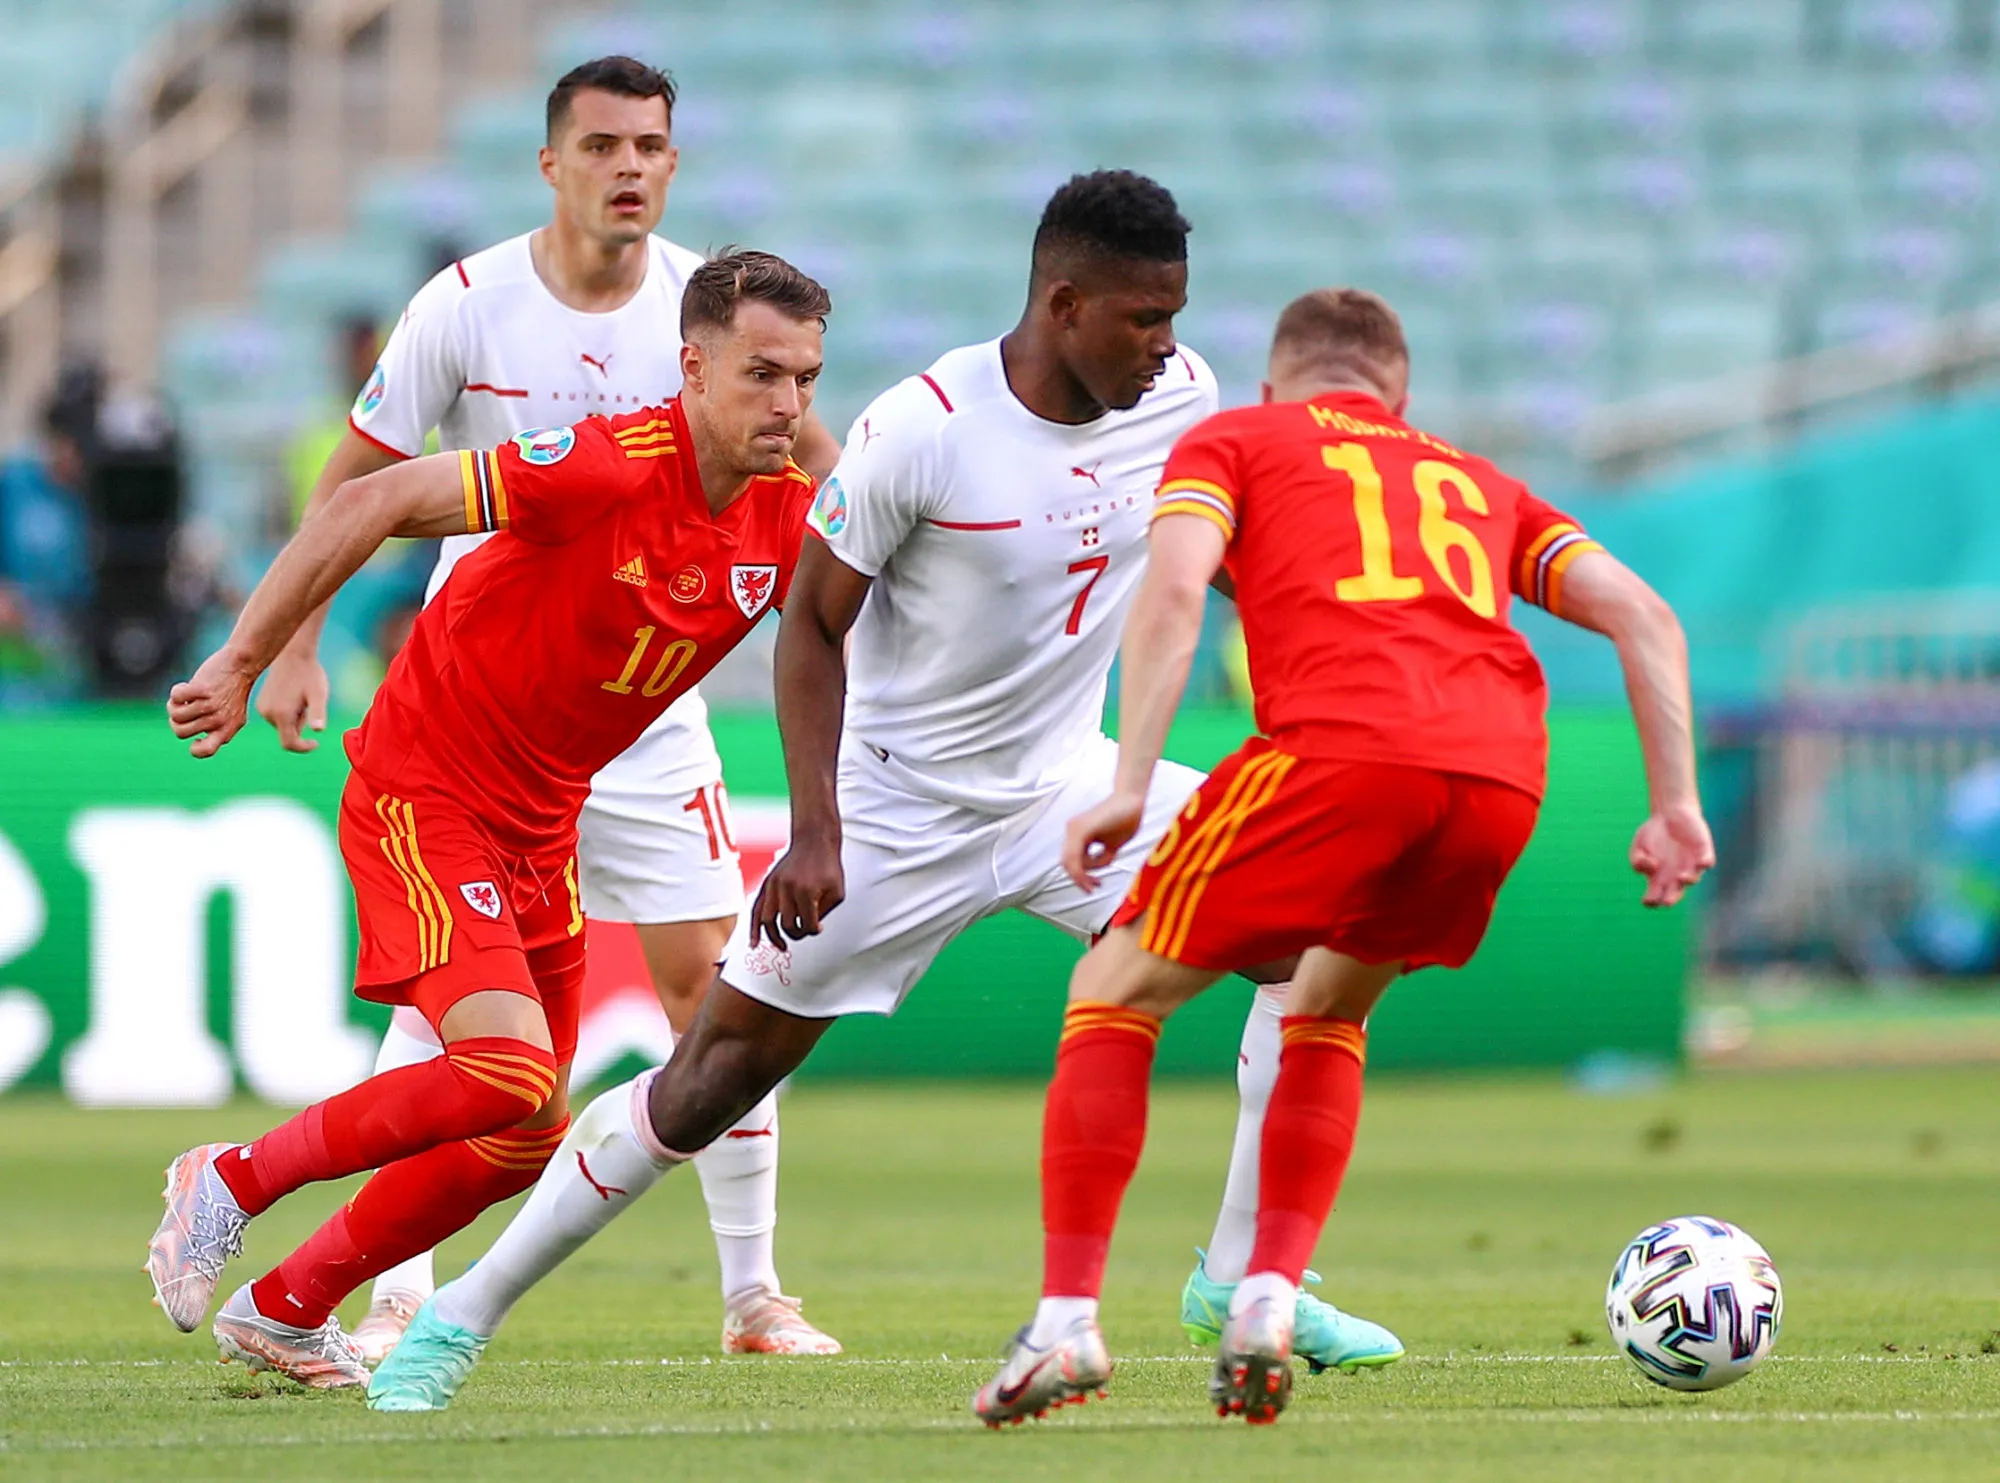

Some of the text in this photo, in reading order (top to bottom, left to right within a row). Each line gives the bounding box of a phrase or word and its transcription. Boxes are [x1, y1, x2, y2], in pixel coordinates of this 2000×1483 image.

[1045, 496, 1134, 523] SUISSE
[1321, 441, 1497, 619] 16
[612, 571, 648, 588] adidas
[1065, 555, 1110, 635] 7
[600, 625, 698, 697] 10
